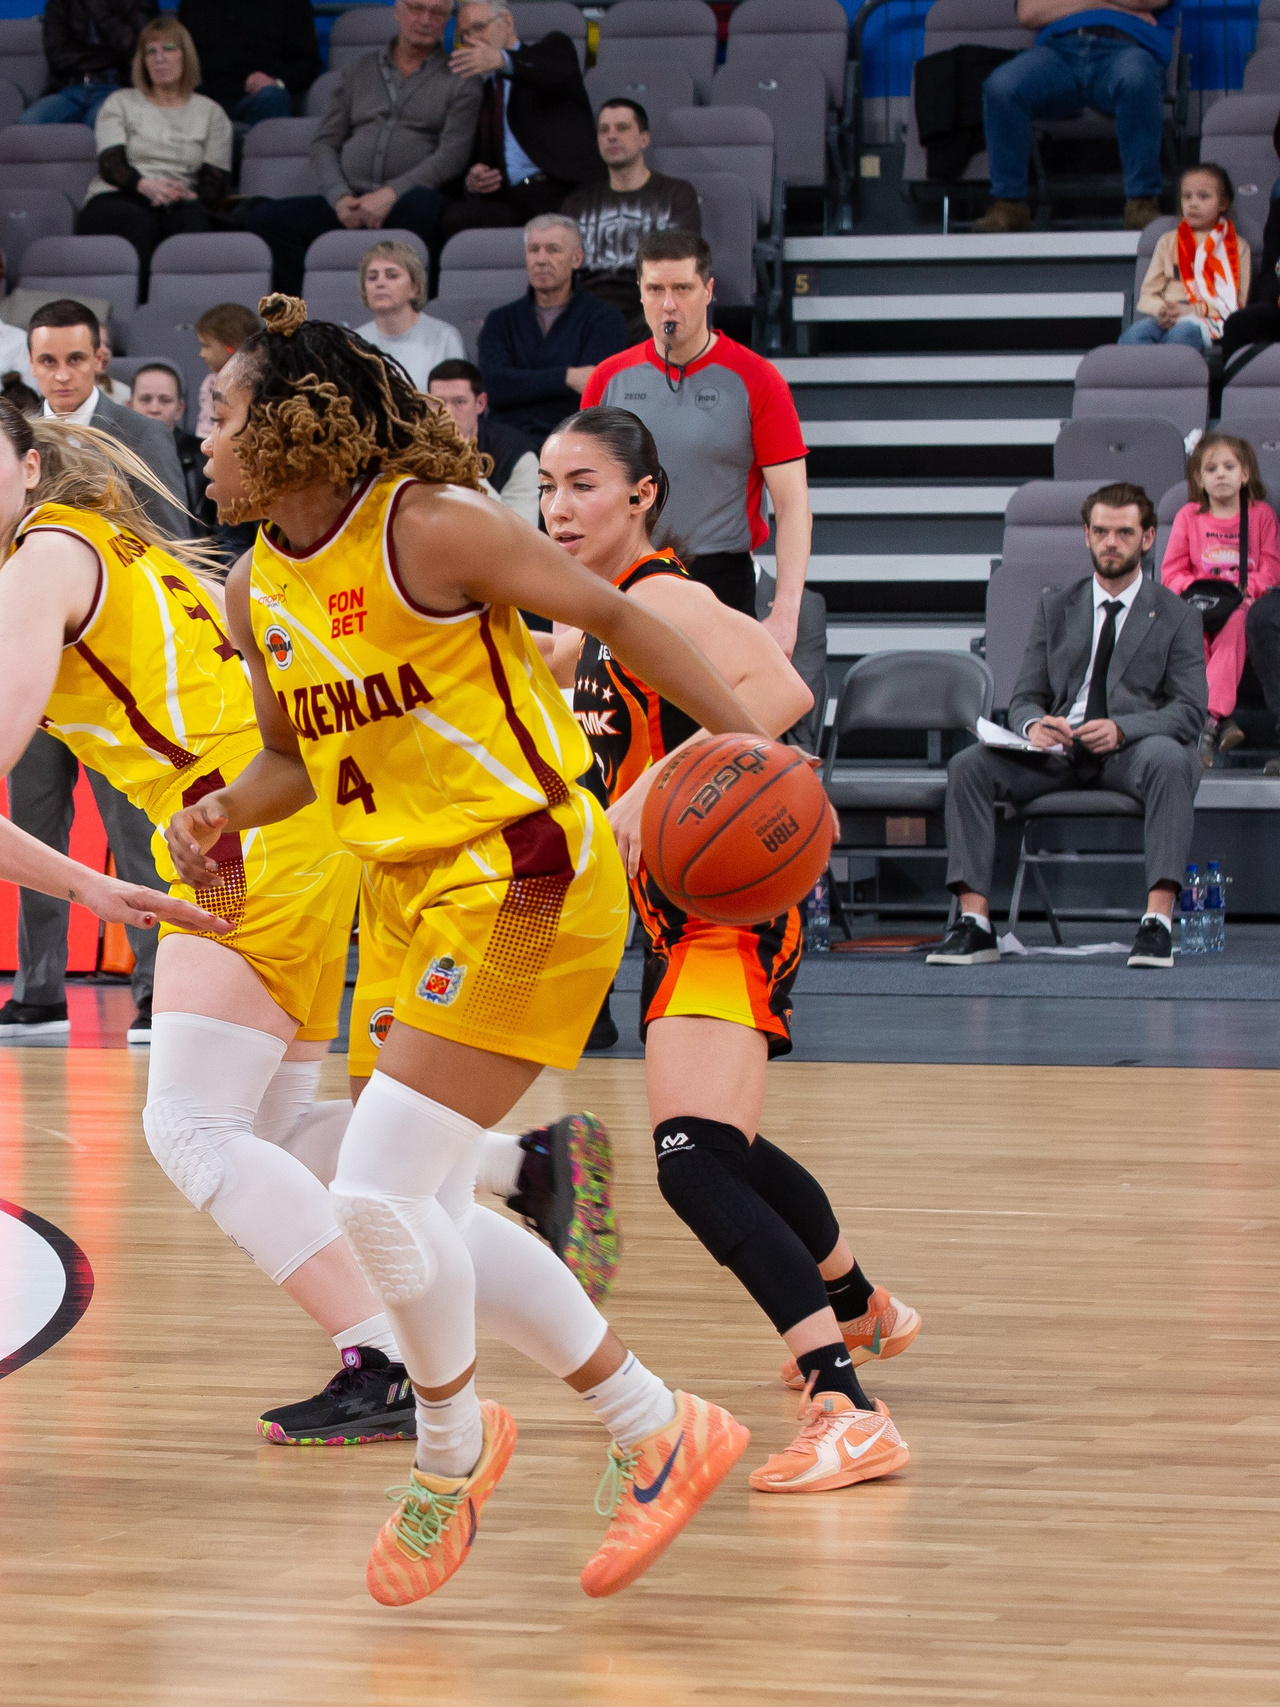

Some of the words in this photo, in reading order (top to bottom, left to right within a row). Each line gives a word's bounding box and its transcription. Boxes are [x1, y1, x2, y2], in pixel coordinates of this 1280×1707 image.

[795, 273, 809, 294] 5
[328, 586, 365, 616] FON
[331, 611, 368, 639] BET
[277, 662, 434, 742] ДЕЖДА
[336, 755, 377, 815] 4
[676, 743, 770, 826] JÖGEL
[761, 814, 801, 854] FIBA
